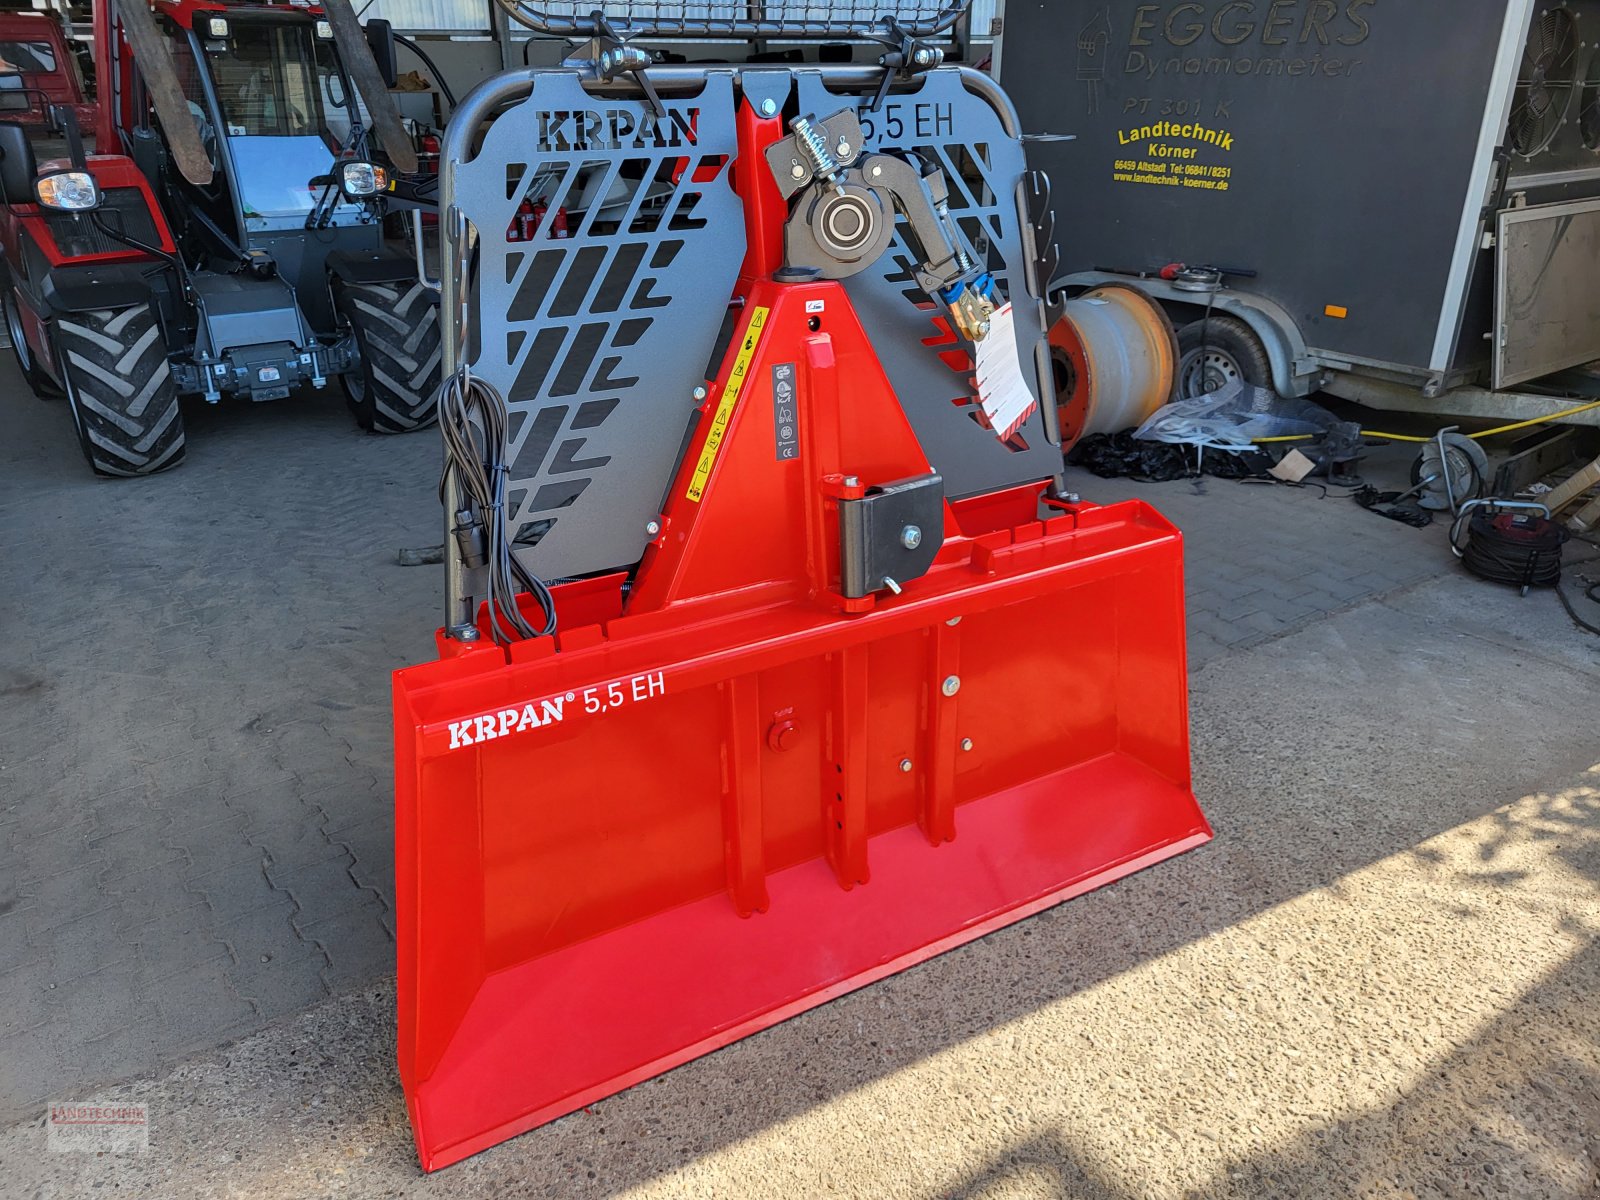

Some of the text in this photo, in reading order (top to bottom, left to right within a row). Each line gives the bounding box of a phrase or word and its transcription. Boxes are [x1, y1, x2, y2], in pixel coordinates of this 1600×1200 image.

[1128, 0, 1376, 46] EGGERS
[1124, 50, 1363, 80] Dynamometer
[915, 102, 953, 137] EH
[1122, 97, 1235, 119] PT 301 K
[535, 107, 701, 152] KRPAN
[1117, 120, 1234, 151] Landtechnik
[1148, 143, 1198, 159] Körner
[1114, 160, 1137, 171] 66459
[1137, 161, 1167, 173] Altstadt
[1170, 163, 1184, 175] Tel:
[782, 447, 793, 458] CE
[583, 682, 624, 713] 5,5
[631, 671, 666, 702] EH
